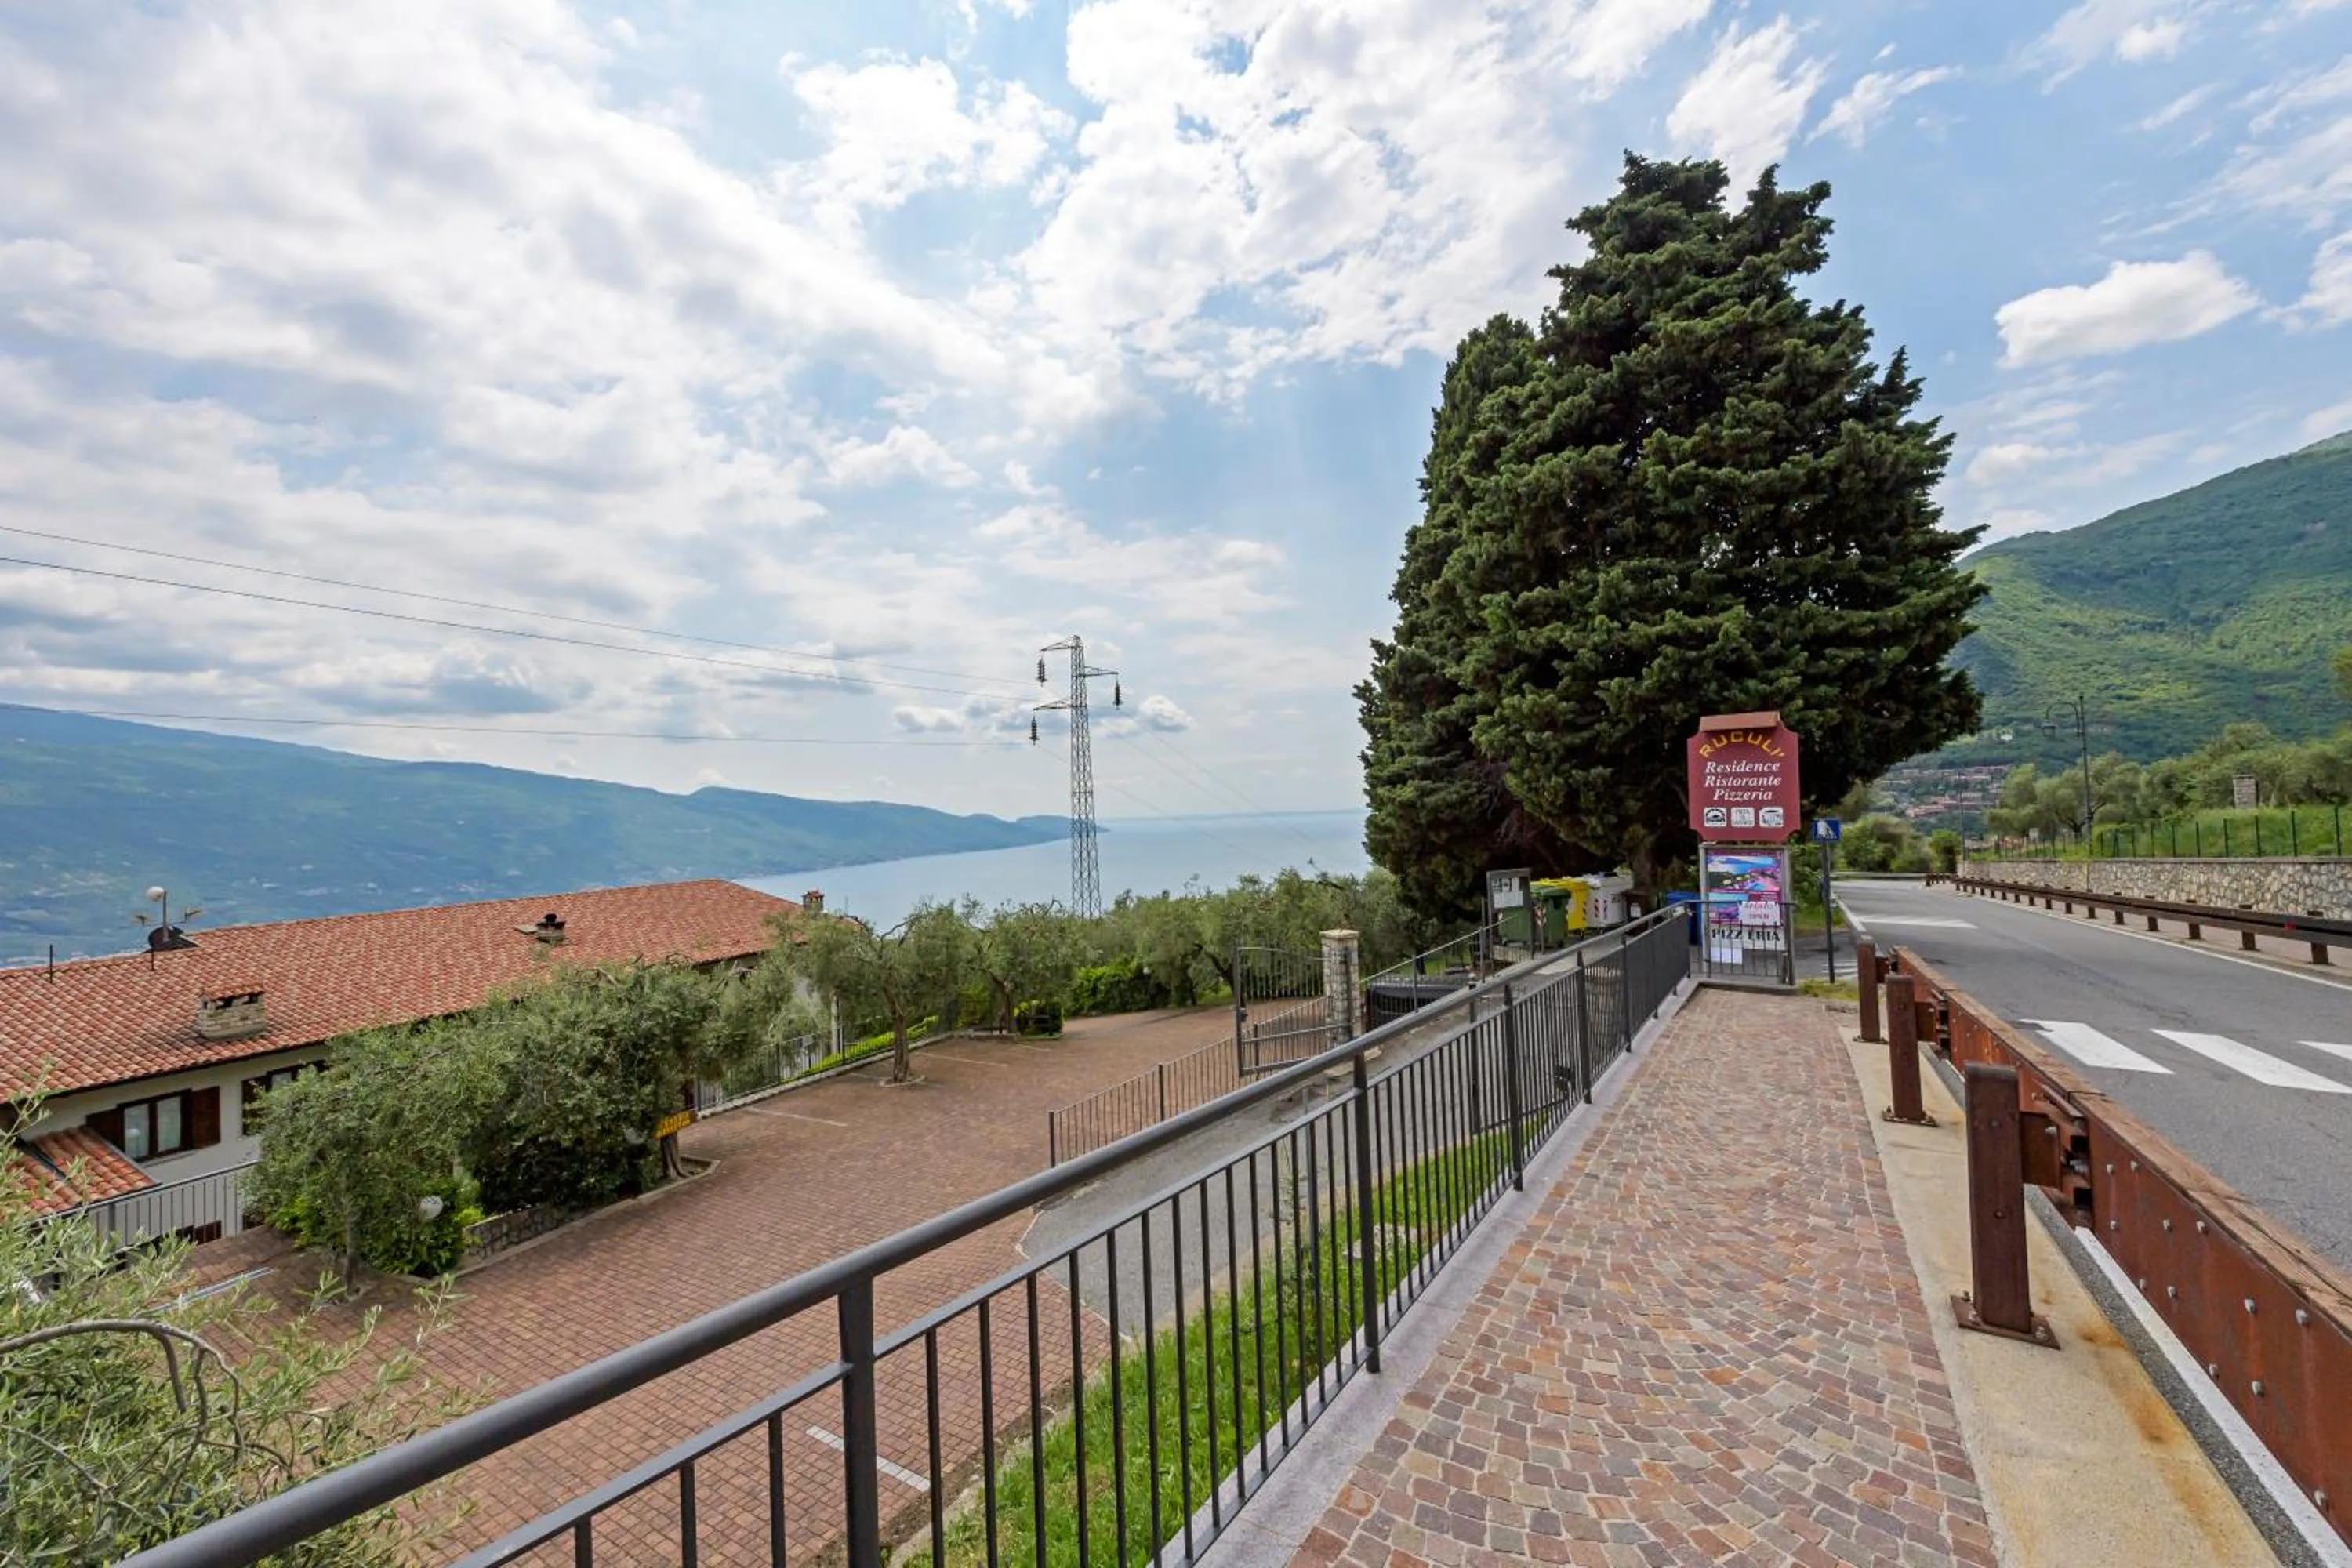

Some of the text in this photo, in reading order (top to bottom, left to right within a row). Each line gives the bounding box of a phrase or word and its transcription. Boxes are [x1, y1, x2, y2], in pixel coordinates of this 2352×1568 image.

[1705, 760, 1780, 774] Residence
[1704, 775, 1782, 787] Ristorante
[1713, 788, 1773, 802] Pizzeria
